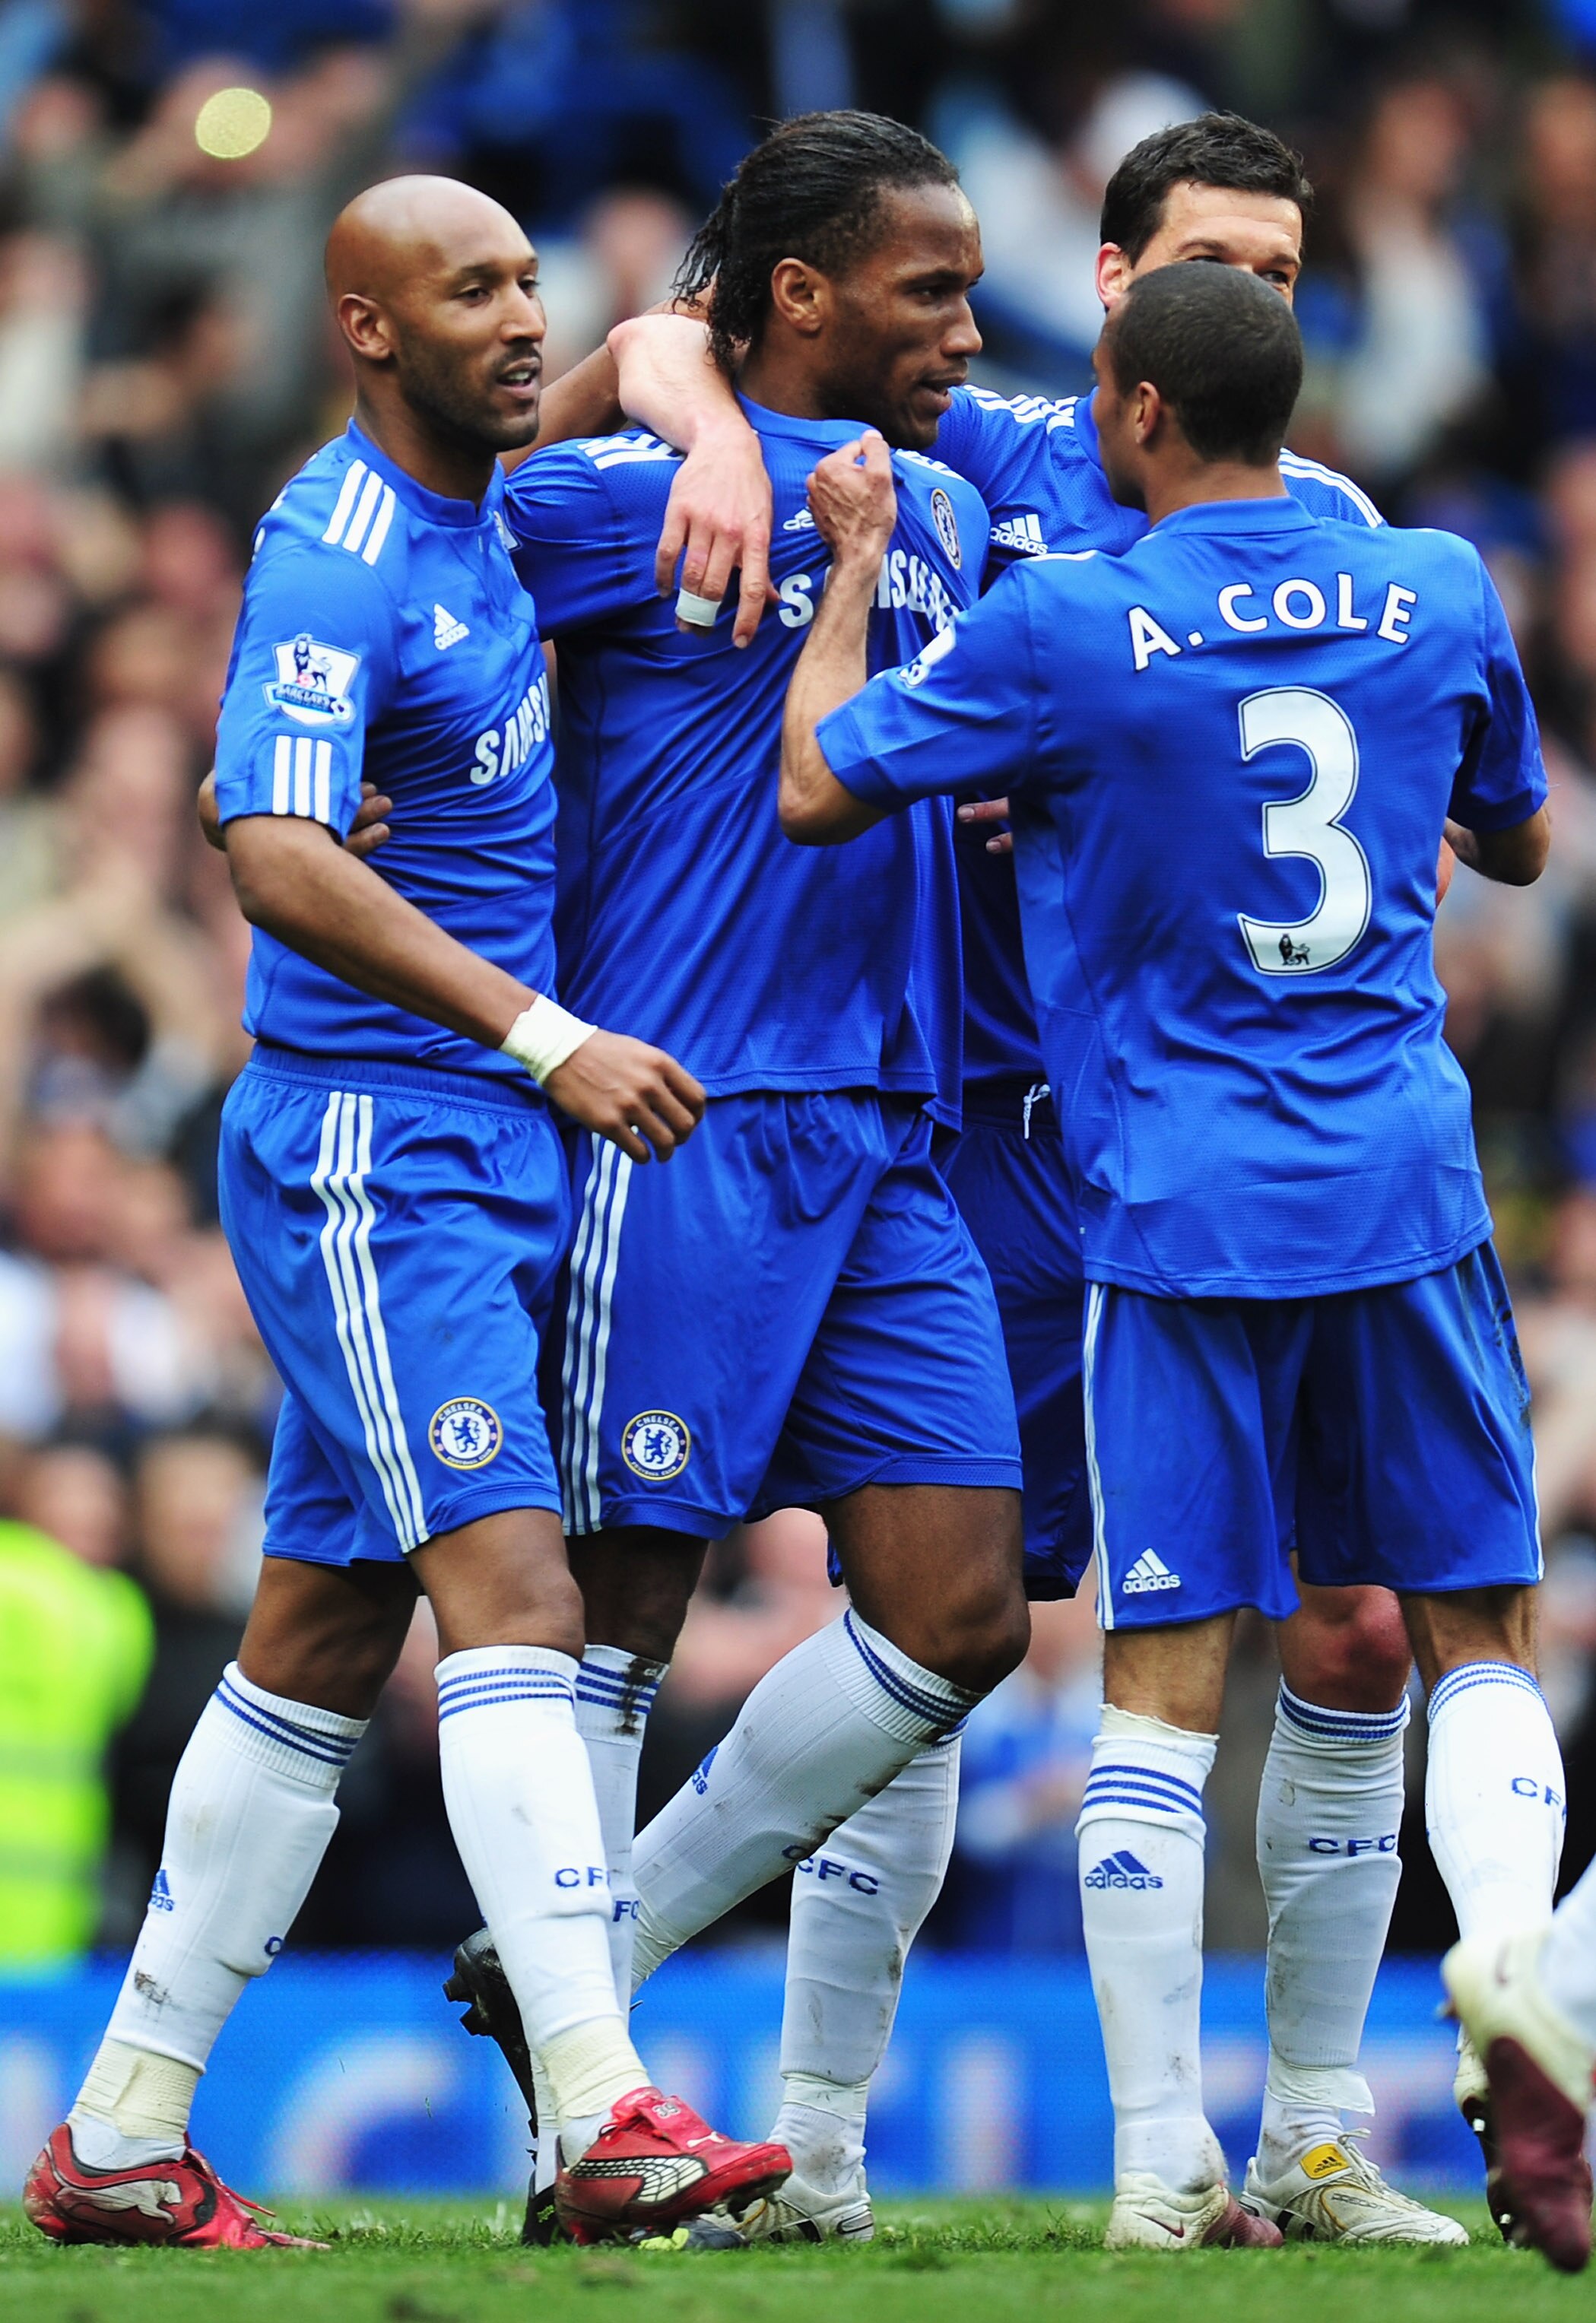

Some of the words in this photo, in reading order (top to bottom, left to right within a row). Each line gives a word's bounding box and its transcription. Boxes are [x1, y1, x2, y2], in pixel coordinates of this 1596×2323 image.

[990, 526, 1049, 555] adidas
[1128, 605, 1205, 672] A.
[1217, 571, 1417, 645] COLE
[1236, 685, 1372, 976] 3
[439, 1402, 483, 1421] CHELSEA
[636, 1415, 680, 1433] CHELSEA
[1122, 1574, 1181, 1594] adidas
[1512, 1777, 1567, 1822] CF
[1309, 1834, 1395, 1857] CFC
[555, 1867, 611, 1888] CF
[1084, 1871, 1163, 1890] adidas
